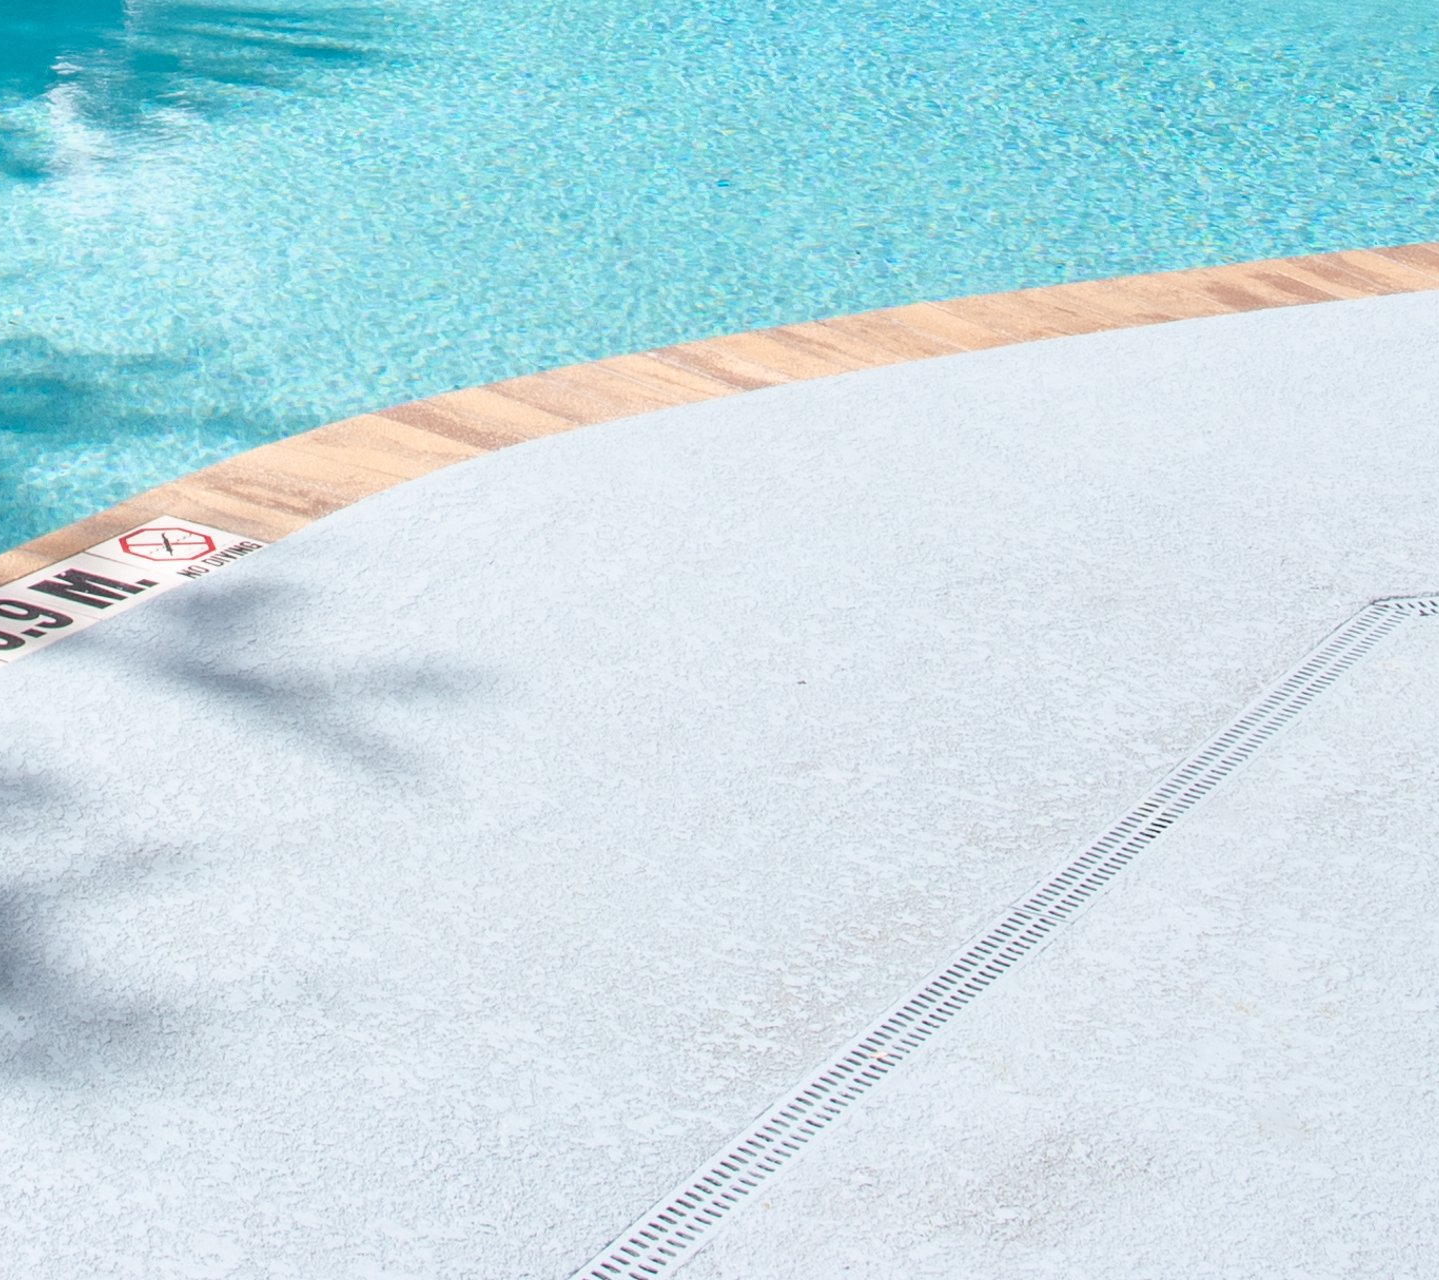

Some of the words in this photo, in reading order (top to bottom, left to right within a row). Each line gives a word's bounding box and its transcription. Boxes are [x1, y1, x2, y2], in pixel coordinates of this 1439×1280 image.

[176, 565, 210, 579] NO
[201, 541, 263, 567] DIVING
[27, 568, 160, 610] M.
